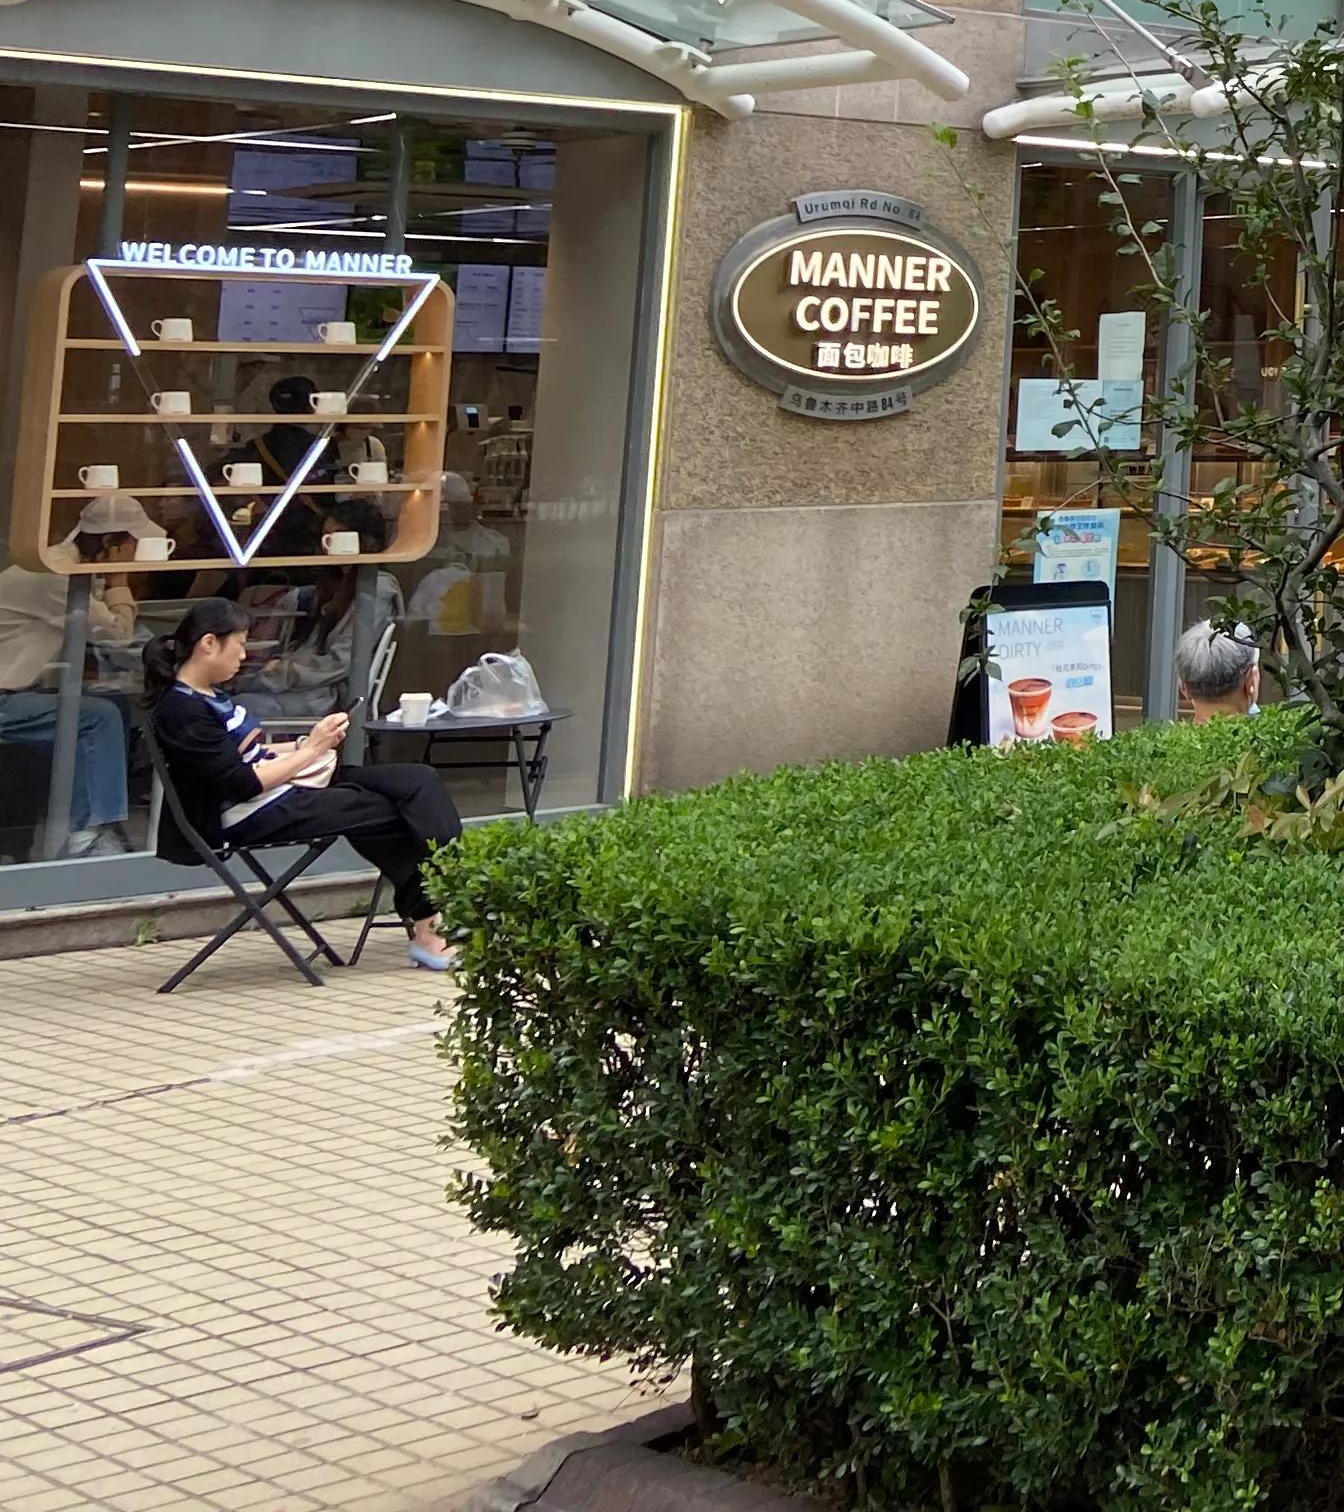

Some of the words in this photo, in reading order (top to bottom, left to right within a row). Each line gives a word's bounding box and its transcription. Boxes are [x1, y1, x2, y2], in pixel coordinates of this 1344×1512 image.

[804, 198, 855, 215] Urumqi
[860, 197, 878, 211] Rd
[883, 199, 905, 216] No.
[120, 241, 257, 268] WELCOME
[259, 248, 297, 270] TO
[303, 249, 414, 275] MANNER
[790, 250, 952, 292] MANNER
[795, 295, 940, 335] COFFEE
[816, 342, 915, 369] 面包咖啡
[998, 617, 1064, 636] MANNER
[999, 641, 1042, 660] DIRTY
